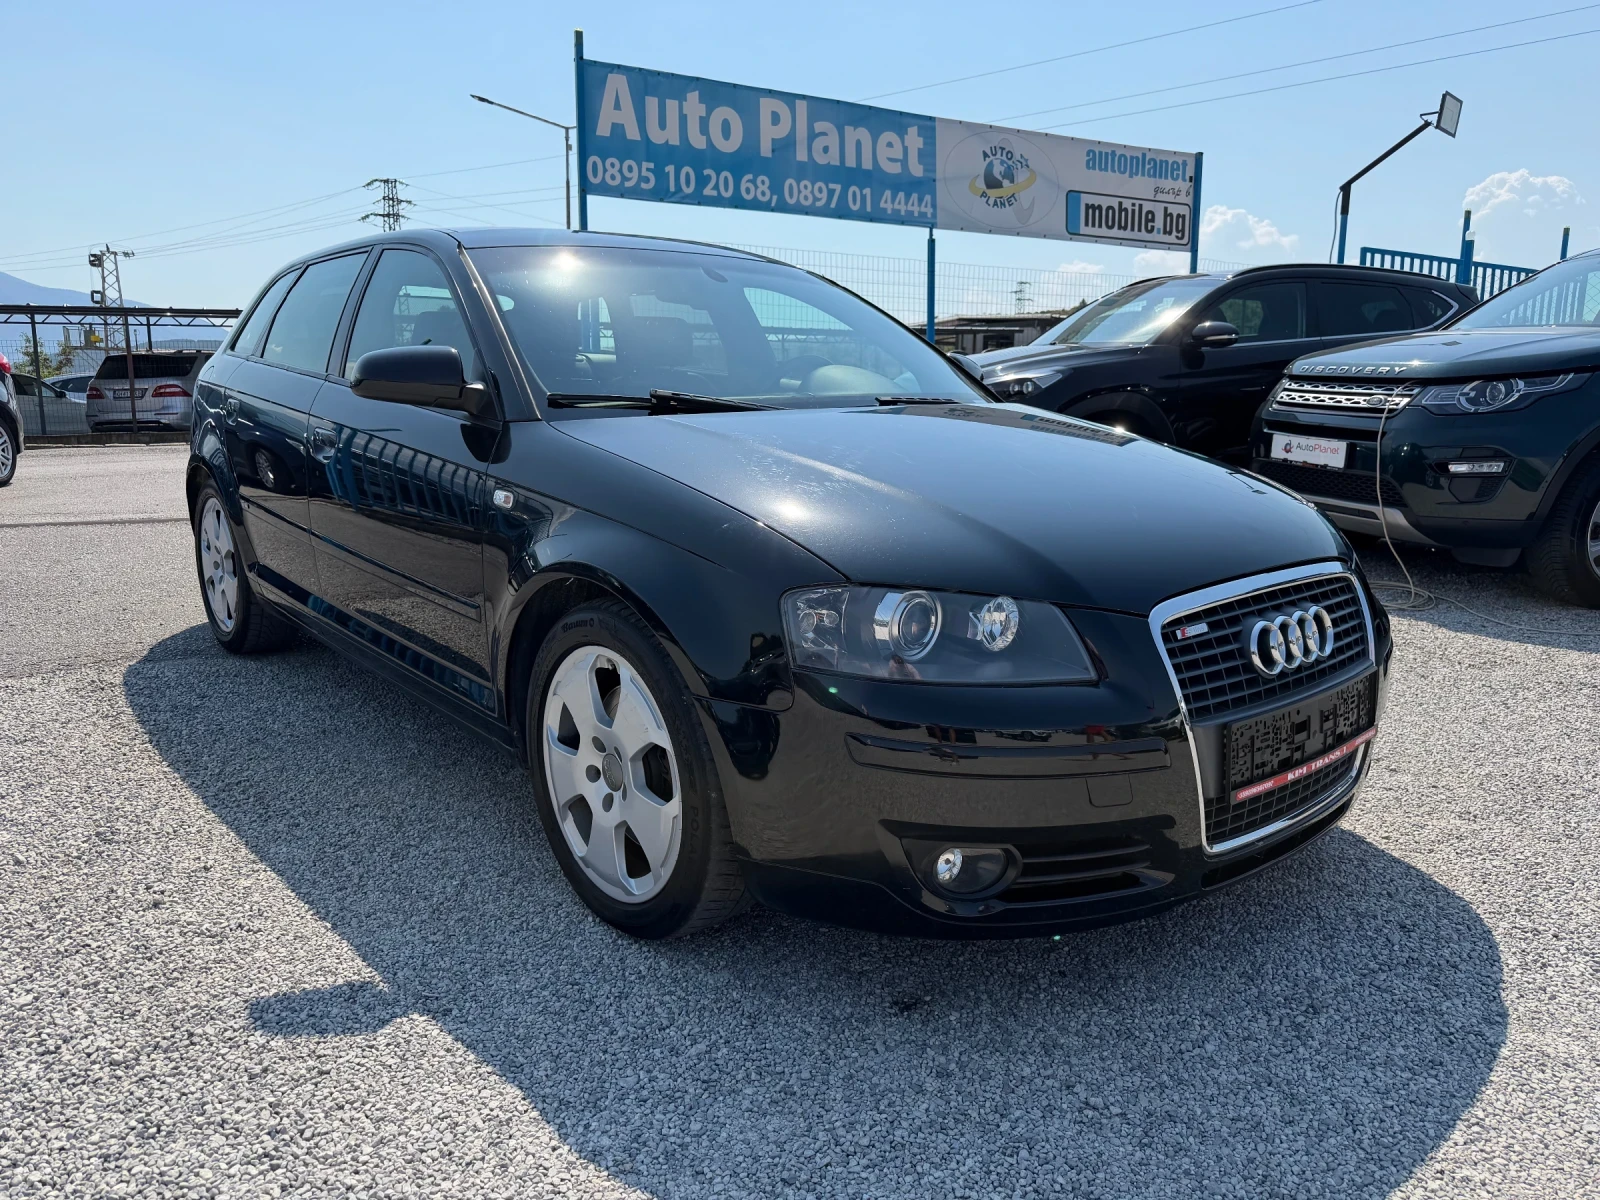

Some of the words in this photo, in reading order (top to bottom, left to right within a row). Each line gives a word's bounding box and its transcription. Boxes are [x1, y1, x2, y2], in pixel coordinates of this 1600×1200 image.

[596, 73, 743, 153] Auto
[759, 97, 924, 177] Planet
[982, 146, 1014, 162] AUTO
[586, 155, 656, 189] 0895
[664, 164, 696, 194] 10
[702, 168, 734, 198] 20
[740, 173, 778, 207] 68,
[783, 178, 841, 209] 0897
[847, 185, 872, 212] 01
[879, 189, 934, 218] 4444
[980, 190, 1018, 209] PLANET
[1084, 200, 1186, 241] mobile.bg
[1300, 365, 1408, 375] DISCOVERY
[1296, 442, 1340, 454] AutoPlanet
[1287, 767, 1307, 780] KIM
